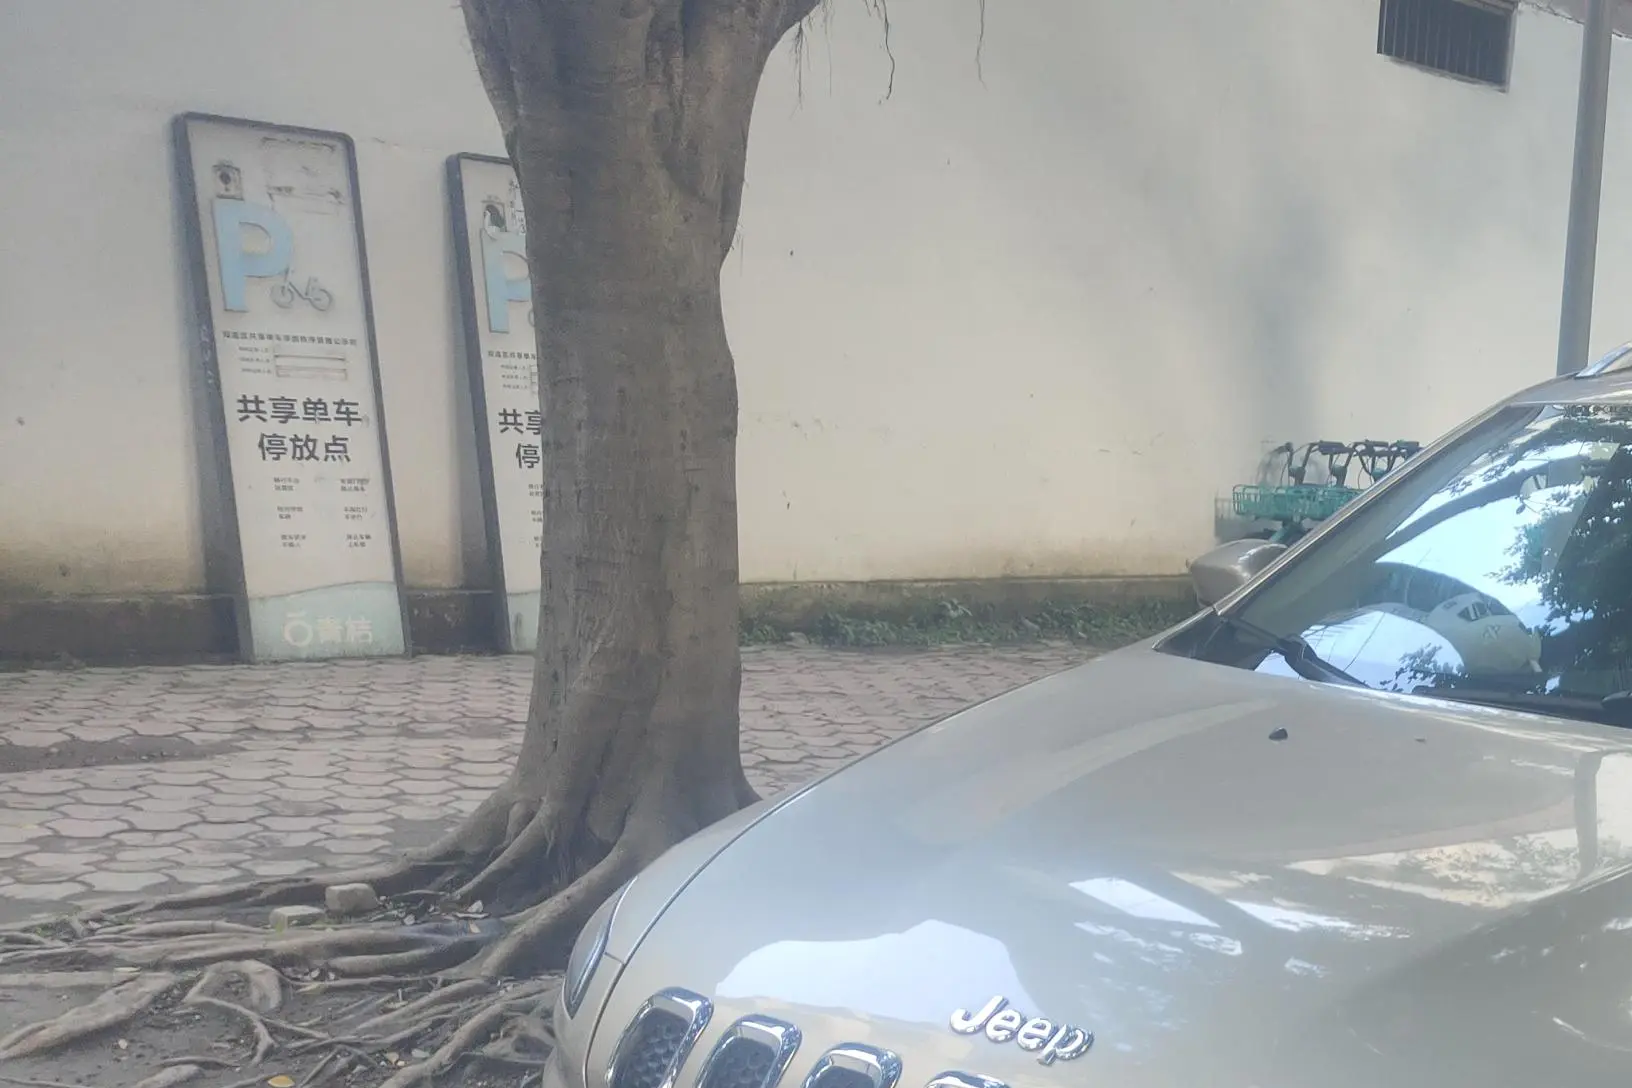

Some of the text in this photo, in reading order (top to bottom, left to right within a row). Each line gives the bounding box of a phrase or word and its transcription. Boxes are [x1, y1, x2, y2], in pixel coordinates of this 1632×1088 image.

[236, 394, 362, 426] 共享单车
[258, 432, 351, 462] 停放点
[950, 995, 1095, 1066] Jeep
